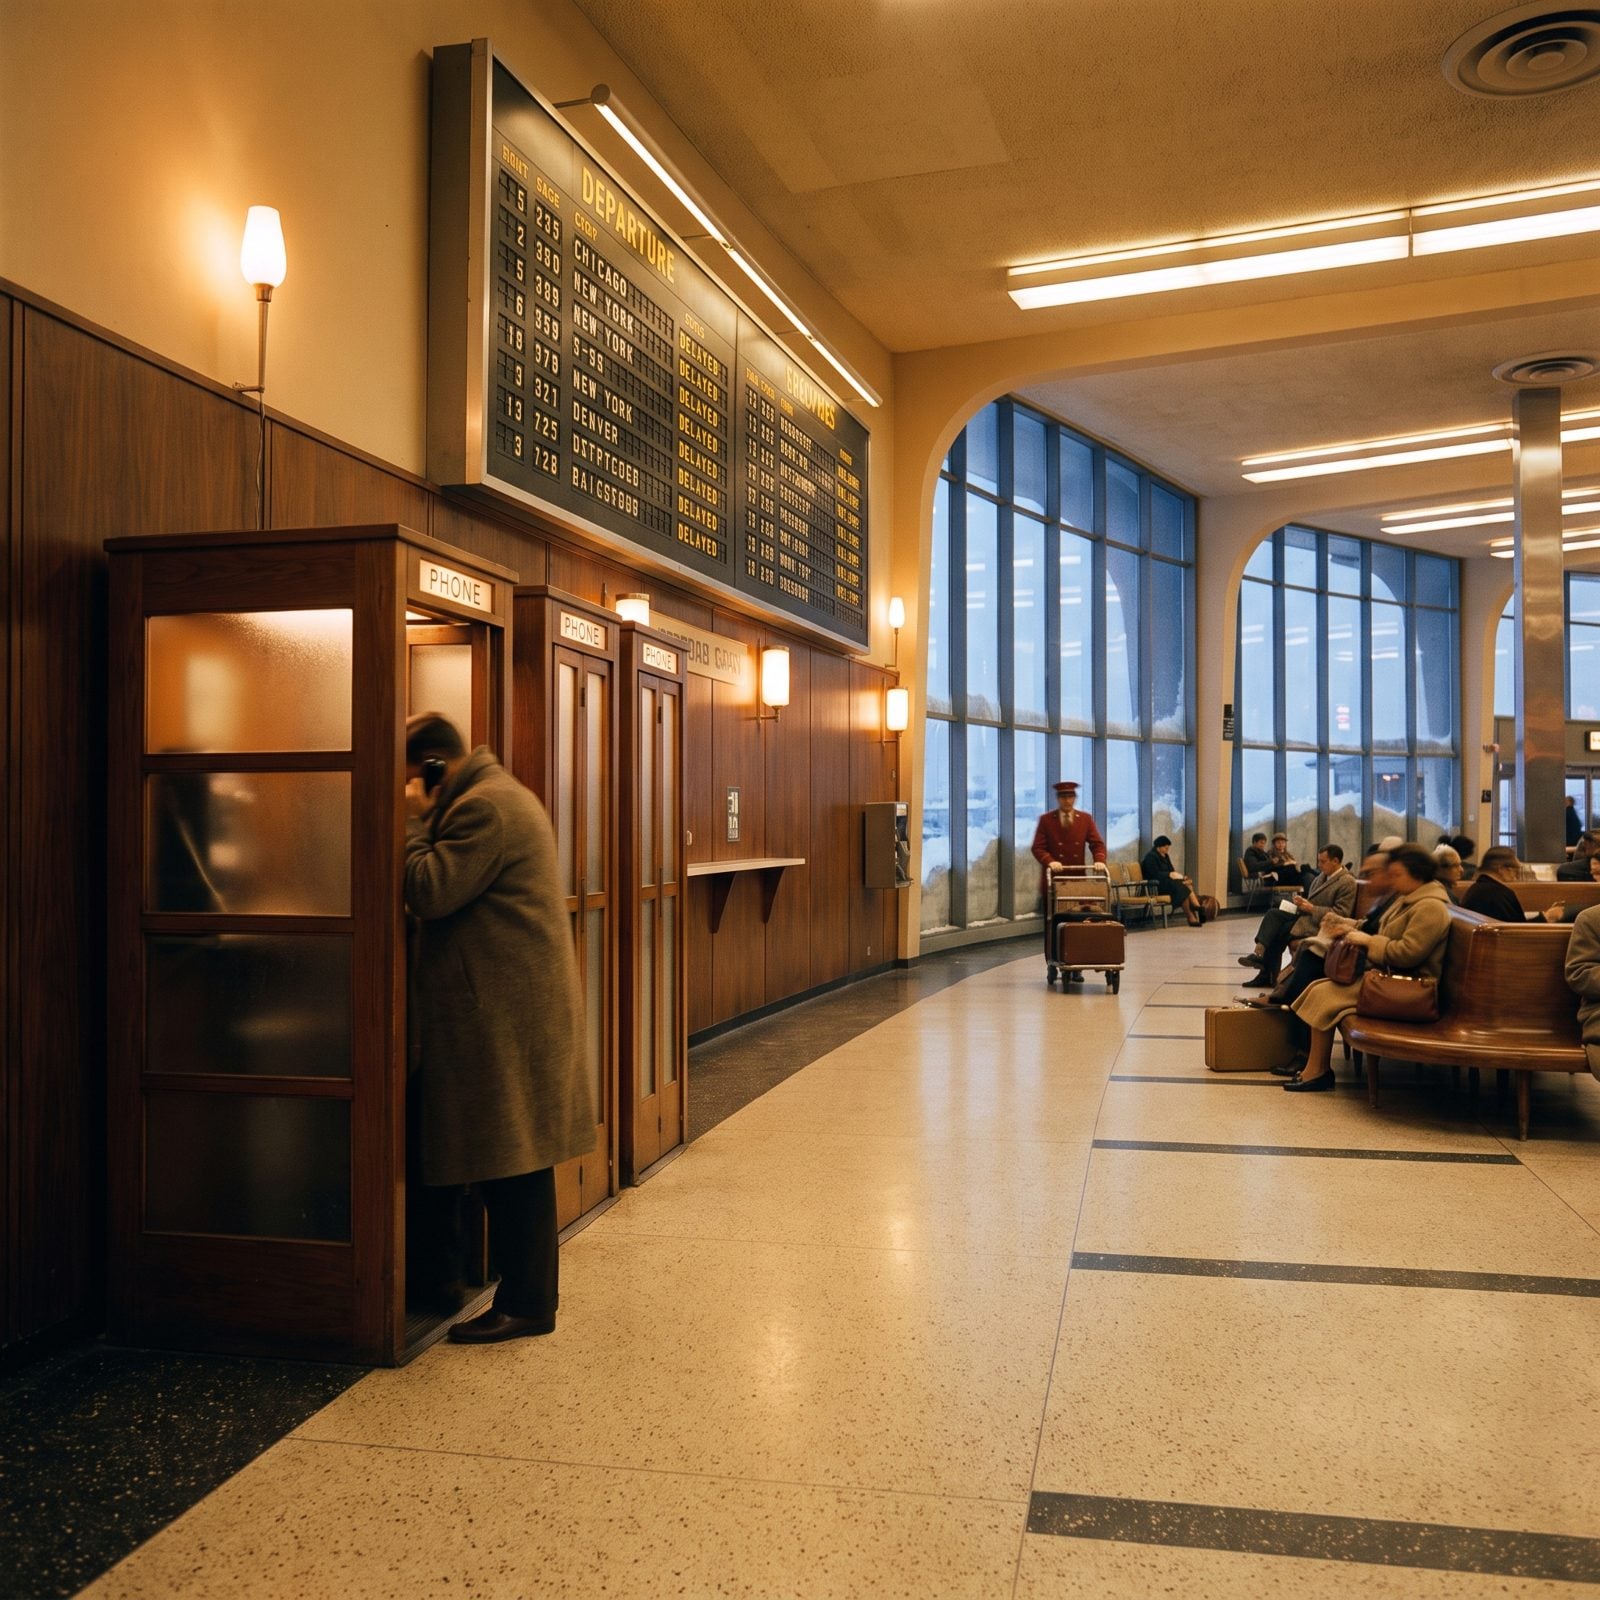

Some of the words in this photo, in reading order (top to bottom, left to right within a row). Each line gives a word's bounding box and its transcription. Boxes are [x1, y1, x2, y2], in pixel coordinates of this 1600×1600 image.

[517, 226, 524, 247] 2
[574, 271, 597, 305] NEW
[605, 296, 633, 334] YORK
[518, 190, 525, 211] 5
[536, 206, 559, 241] 235
[574, 239, 627, 297] CHICAGO
[582, 166, 675, 284] DEPARTURE
[516, 260, 524, 281] 5
[536, 275, 559, 307] 389
[574, 304, 597, 337] NEW
[605, 328, 633, 364] YORK
[680, 386, 718, 428] DELAYED
[516, 296, 523, 316] 6
[535, 309, 559, 341] 359
[679, 413, 718, 453] DELAYED
[507, 396, 522, 421] 13
[535, 412, 558, 441] 725
[678, 495, 717, 531] DELAYED
[535, 344, 558, 374] 378
[573, 369, 597, 400] NEW
[605, 390, 632, 424] YORK
[679, 440, 718, 480] DELAYED
[535, 378, 557, 407] 321
[573, 401, 618, 445] DENVER
[678, 467, 717, 505] DELAYED
[515, 436, 522, 457] 3
[535, 447, 557, 475] 728
[678, 523, 717, 557] DELAYED
[430, 568, 481, 606] PHONE
[565, 617, 599, 645] PHONE
[645, 647, 672, 670] PHONE
